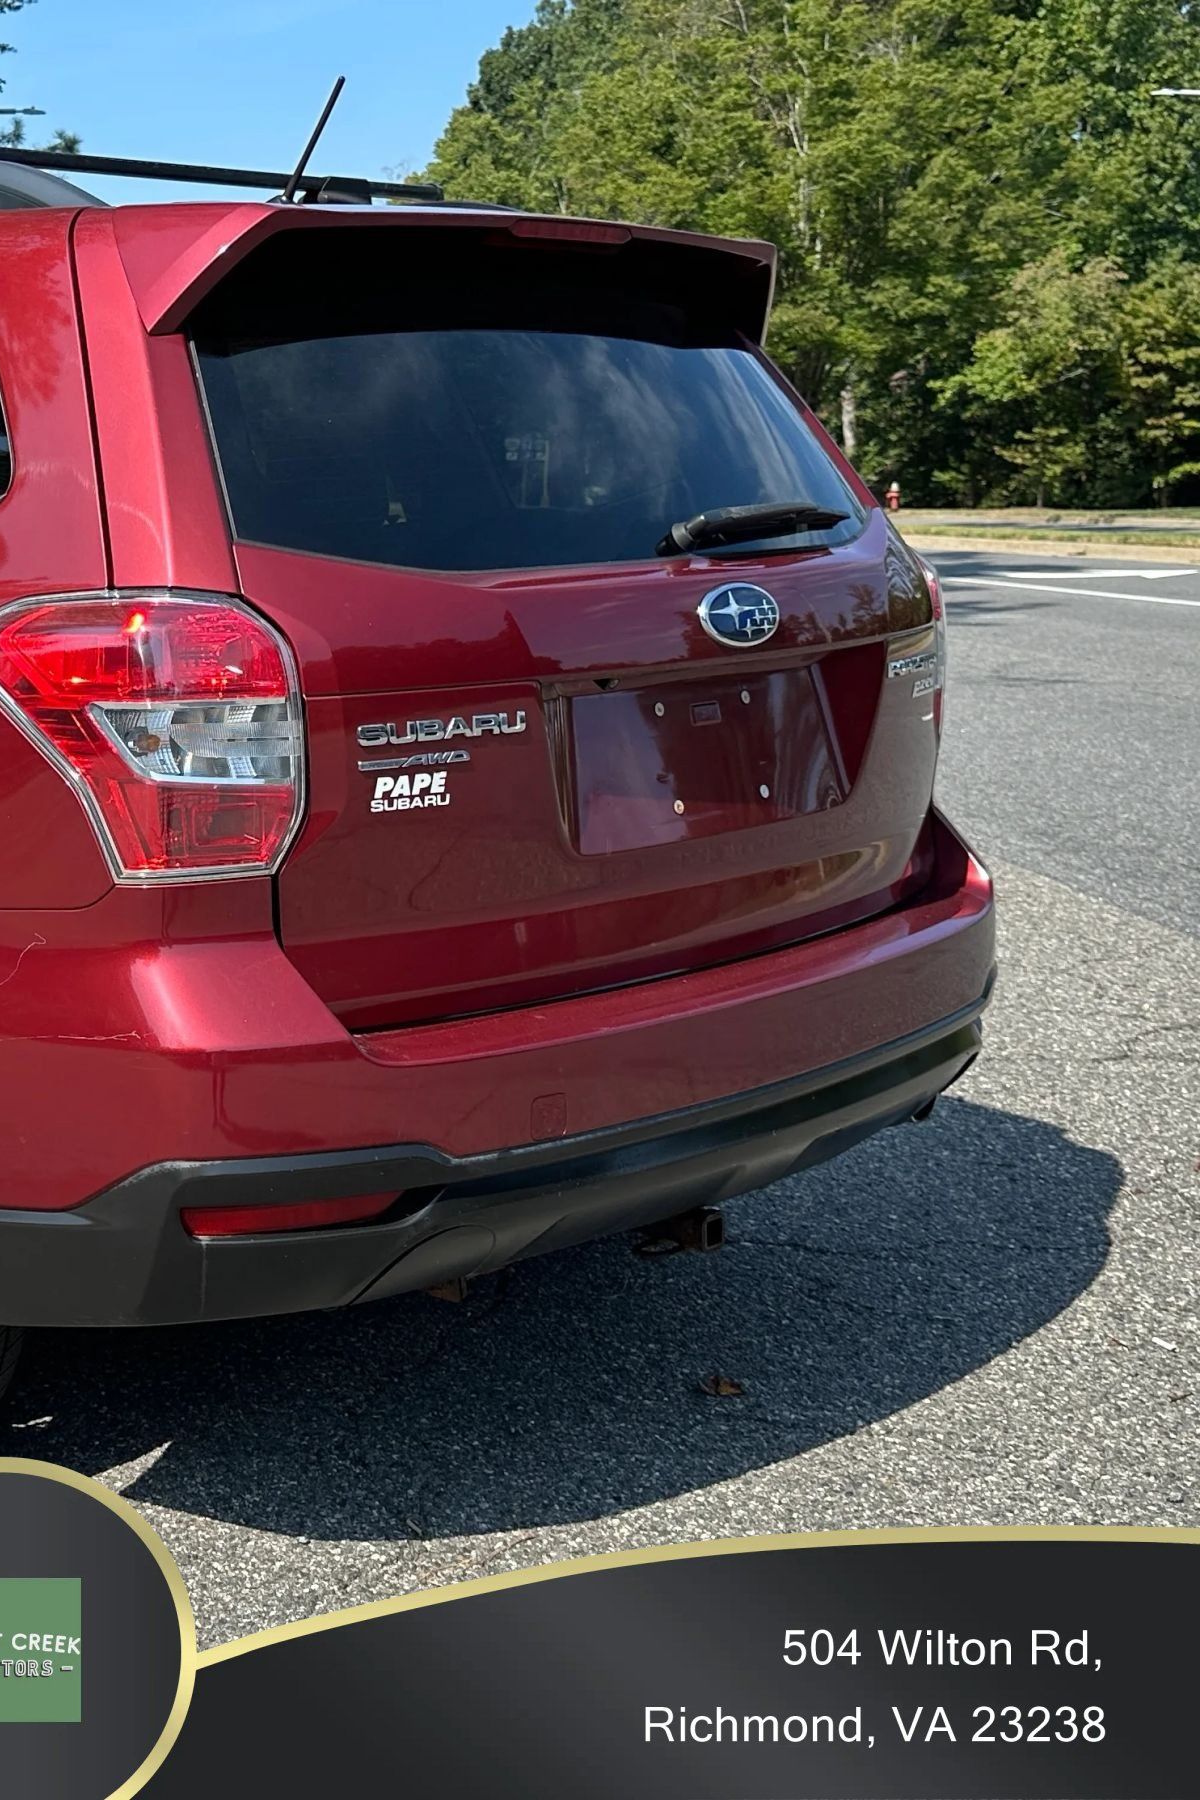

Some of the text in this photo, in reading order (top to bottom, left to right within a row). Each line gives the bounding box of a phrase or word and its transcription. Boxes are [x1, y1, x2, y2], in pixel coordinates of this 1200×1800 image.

[357, 711, 526, 747] SUBARU
[402, 750, 471, 768] AWD
[374, 771, 448, 799] PAPE
[370, 793, 451, 813] SUBARU
